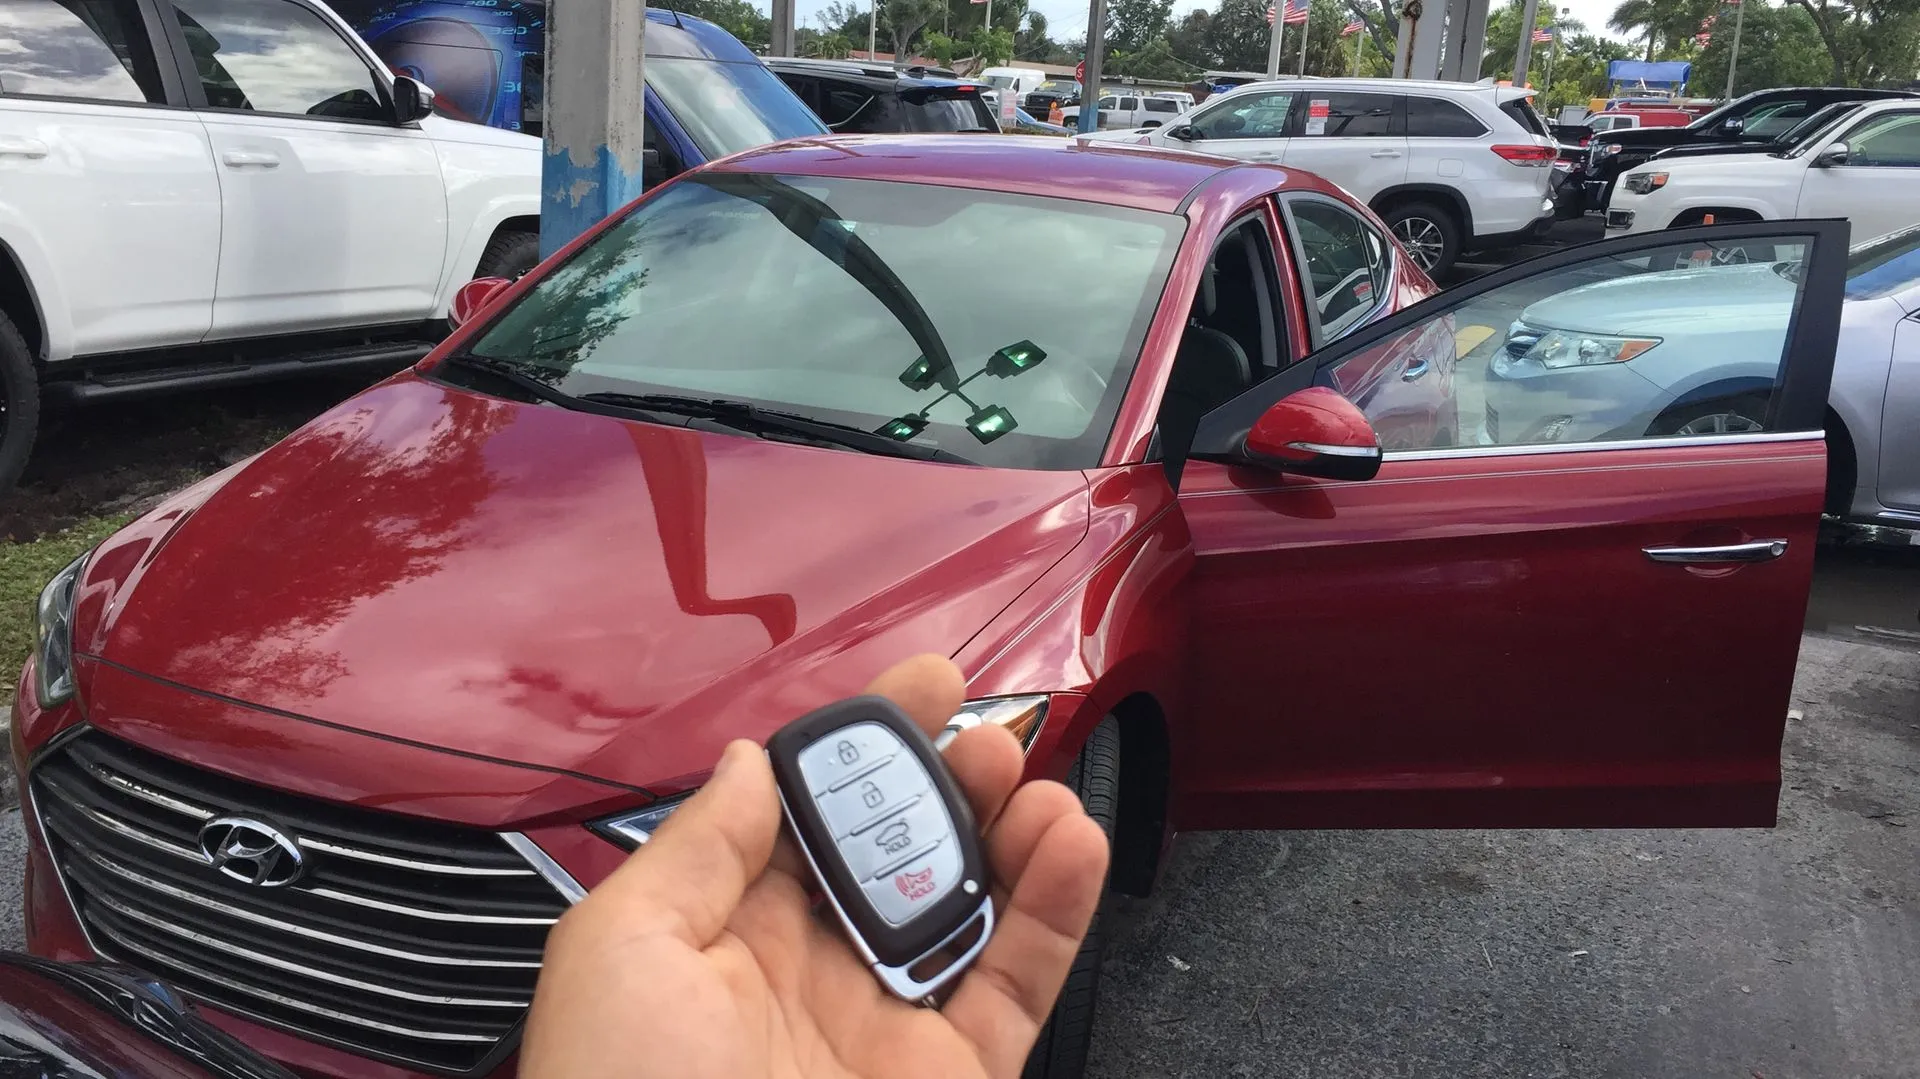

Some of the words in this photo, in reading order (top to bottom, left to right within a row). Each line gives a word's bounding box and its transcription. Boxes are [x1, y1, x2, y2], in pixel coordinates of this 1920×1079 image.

[489, 26, 527, 35] 320
[885, 836, 911, 855] HOLD
[909, 881, 935, 900] HOLD
